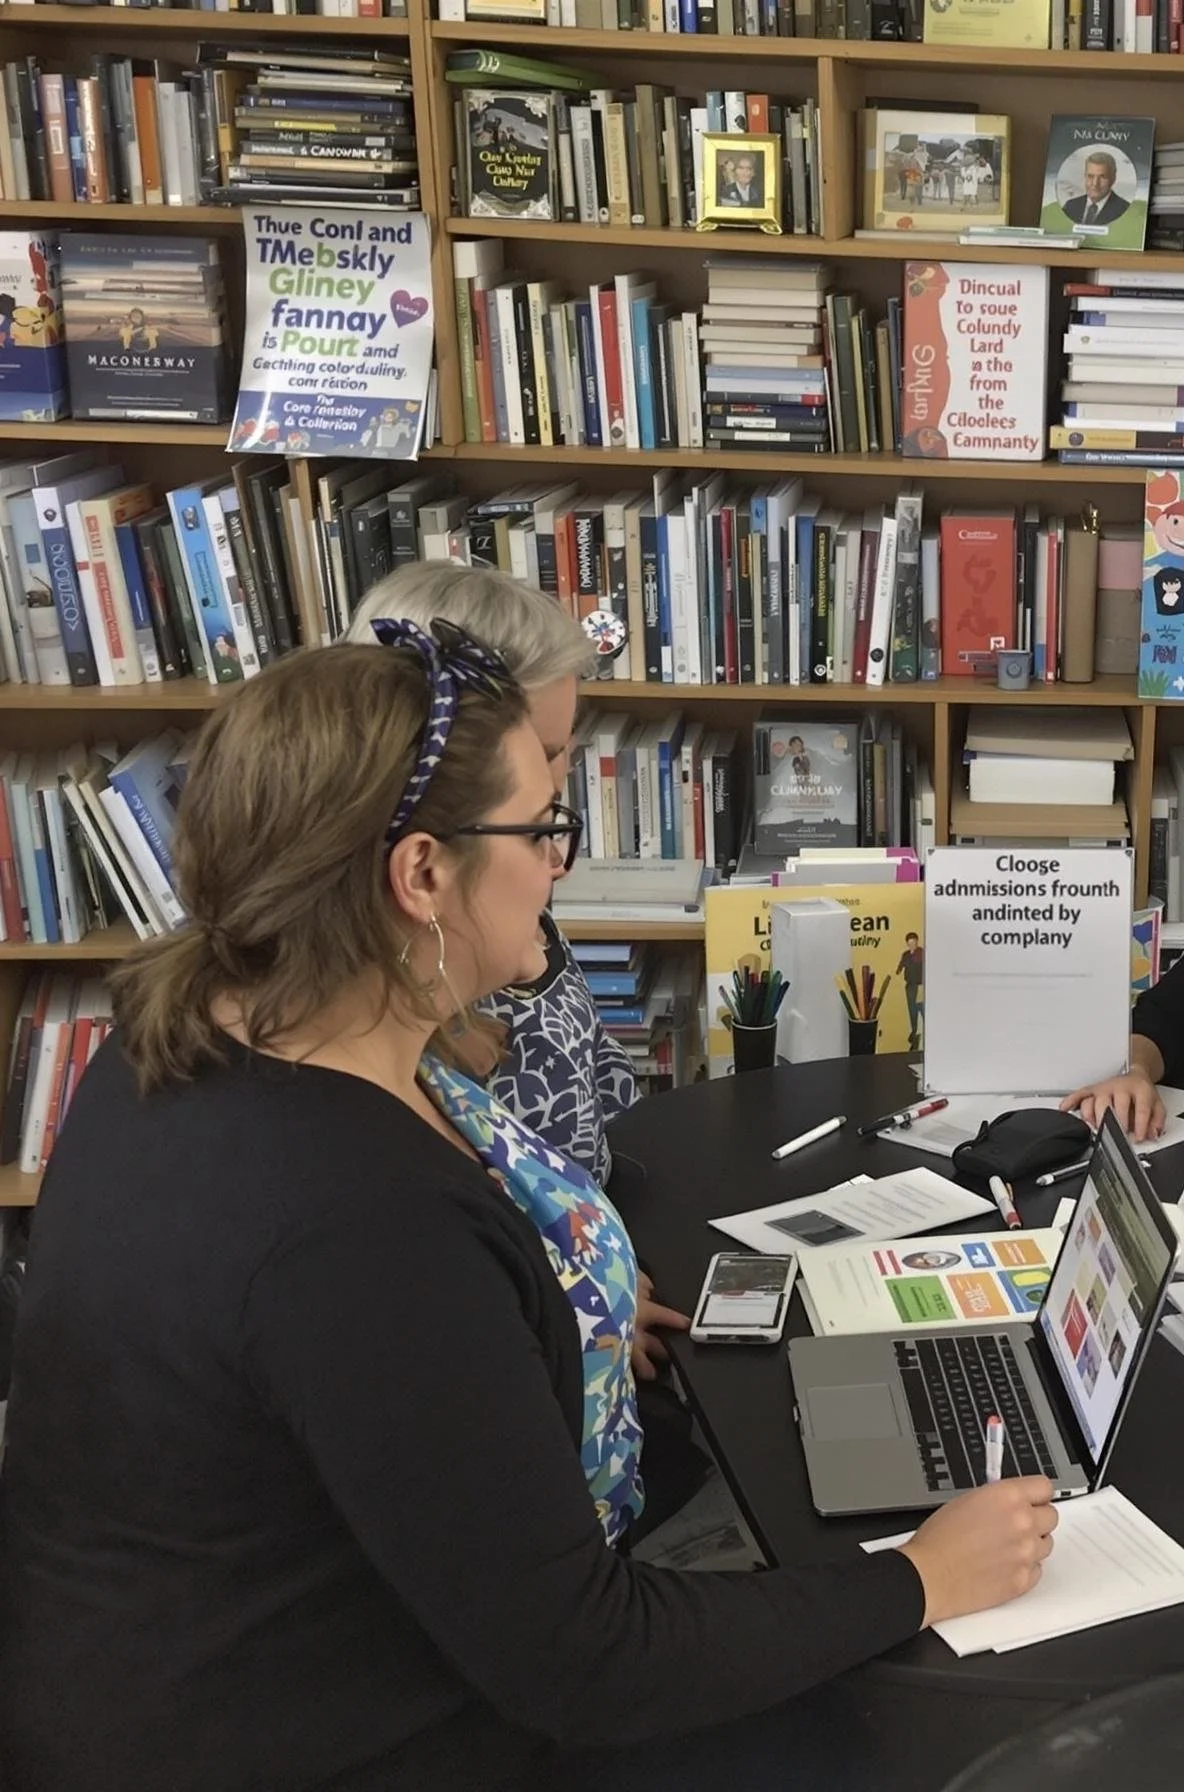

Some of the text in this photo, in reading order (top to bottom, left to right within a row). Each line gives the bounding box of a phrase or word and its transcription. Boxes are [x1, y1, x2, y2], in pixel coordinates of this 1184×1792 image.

[253, 215, 303, 236] Thue
[367, 221, 413, 245] and
[269, 267, 376, 307] Gliney
[956, 318, 1022, 339] Colundy
[262, 331, 278, 349] is
[969, 374, 1008, 392] from
[977, 393, 1005, 411] the
[1051, 878, 1121, 898] frounth
[971, 903, 1082, 925] andinted by
[753, 914, 891, 937] Li ean
[980, 927, 1074, 950] complany
